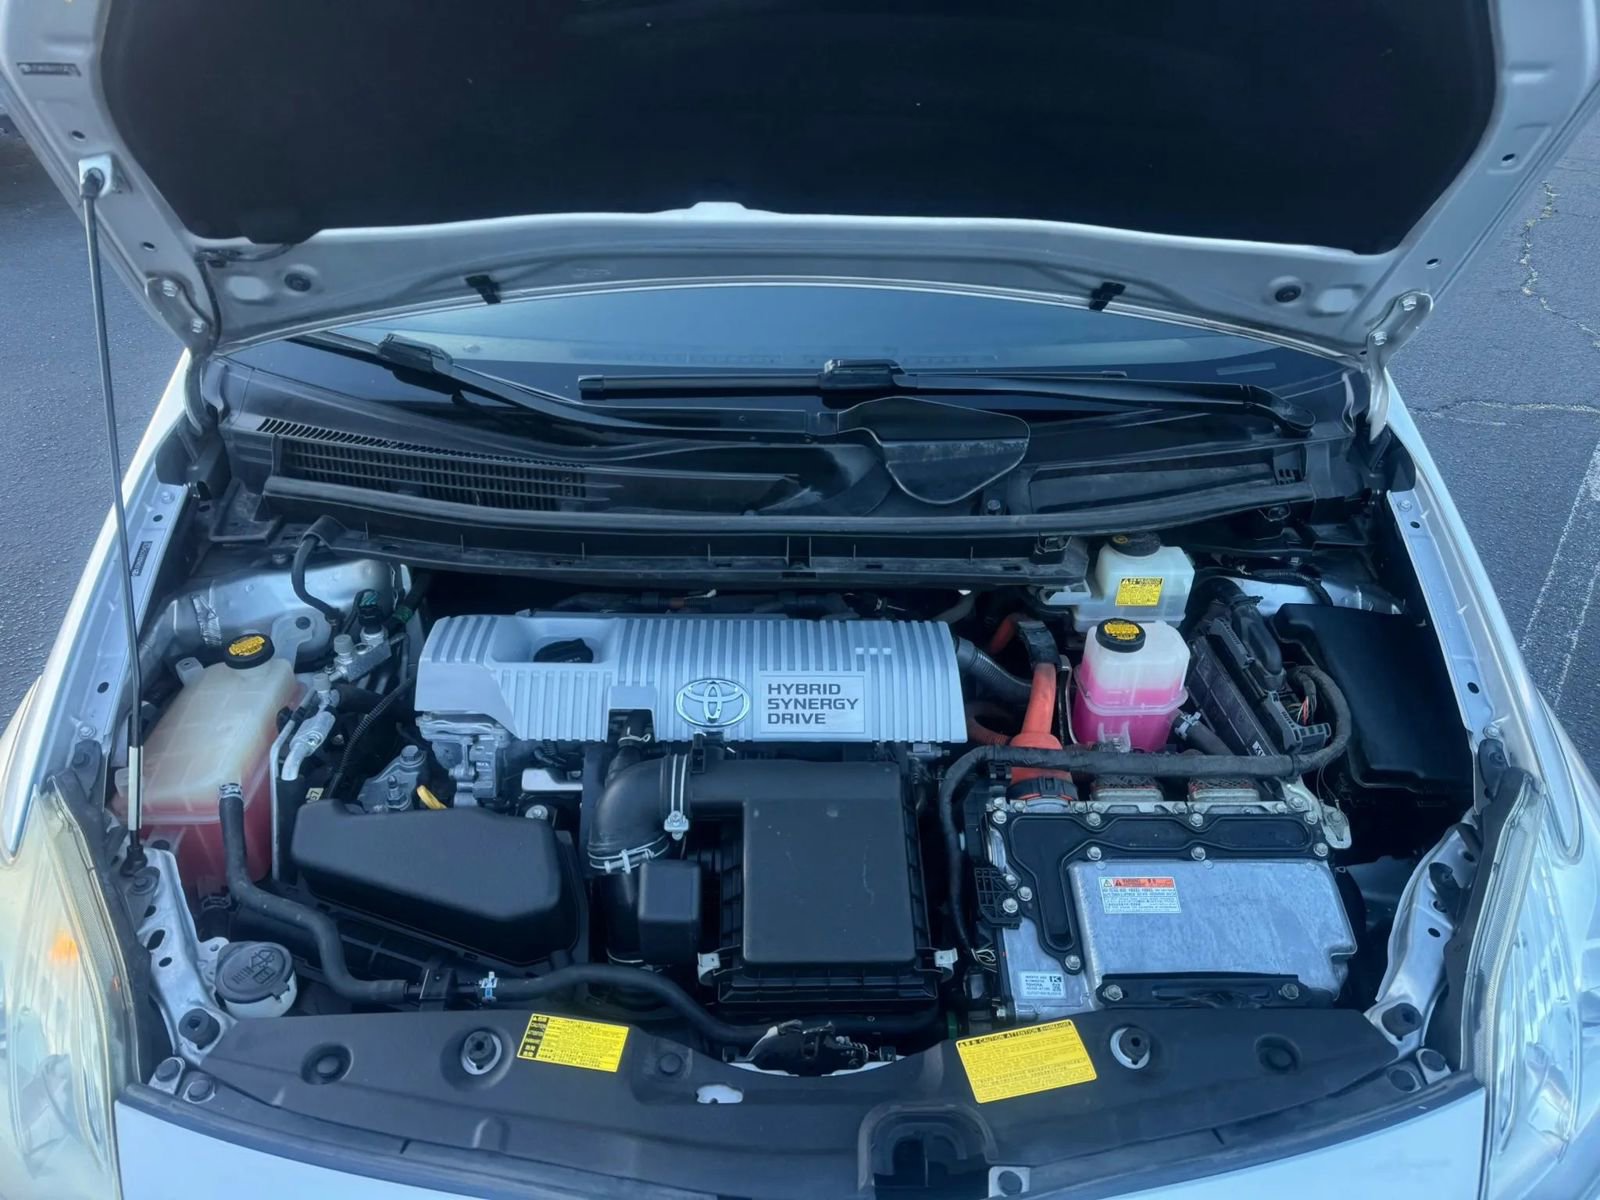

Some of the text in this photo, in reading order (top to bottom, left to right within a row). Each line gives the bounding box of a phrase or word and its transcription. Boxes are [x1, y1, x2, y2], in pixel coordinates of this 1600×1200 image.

[768, 683, 841, 695] HYBRID
[768, 698, 859, 710] SYNERGY
[768, 712, 826, 725] DRIVE
